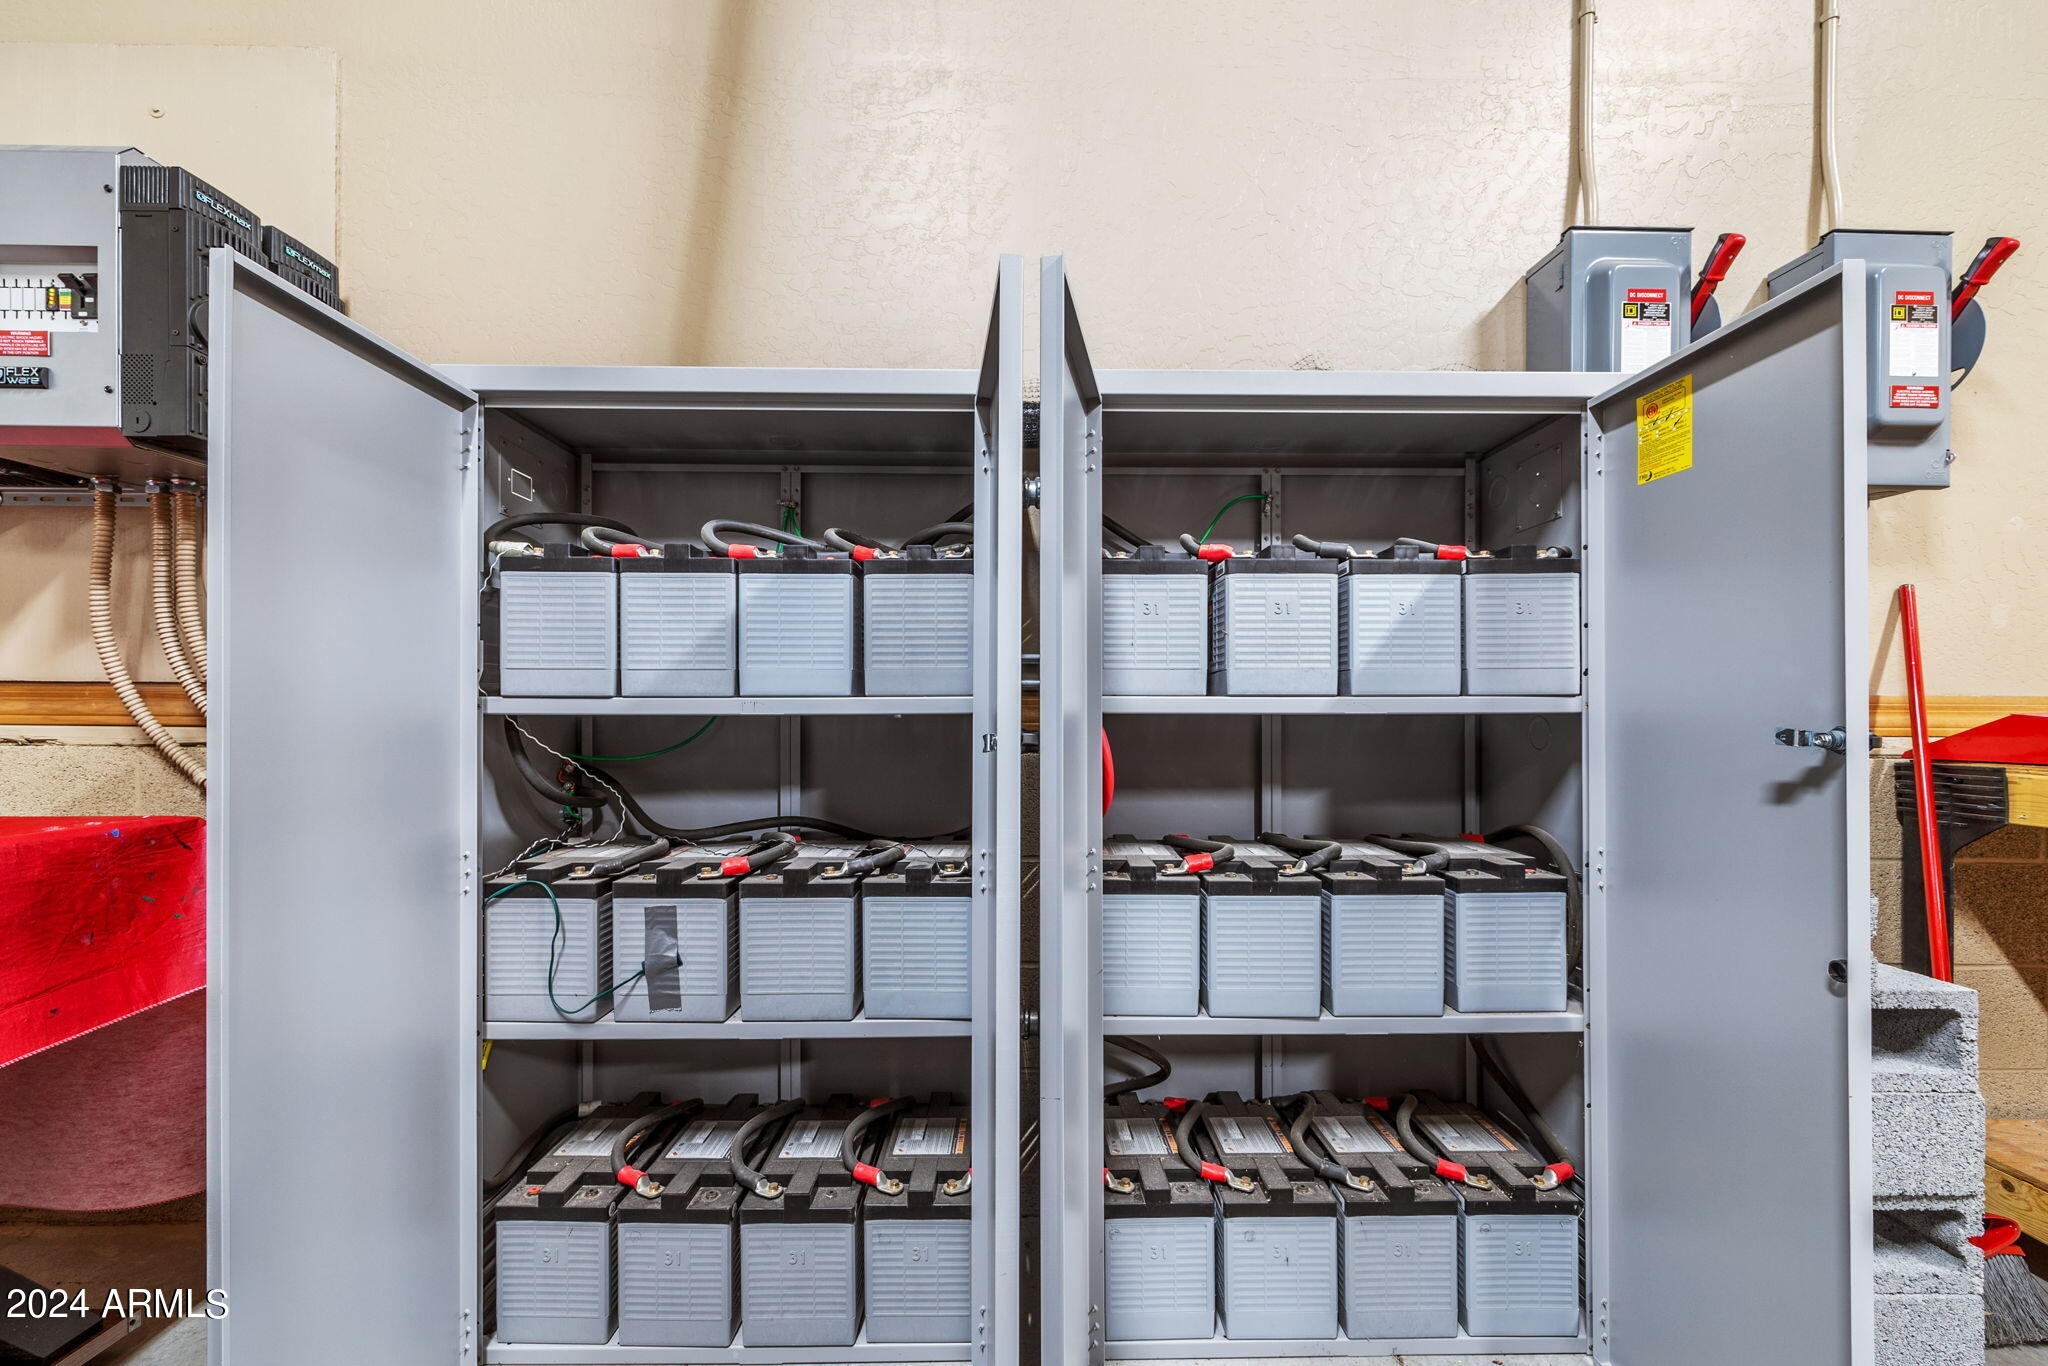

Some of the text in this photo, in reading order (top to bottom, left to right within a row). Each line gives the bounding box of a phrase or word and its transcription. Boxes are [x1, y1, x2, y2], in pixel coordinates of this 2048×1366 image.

[205, 196, 252, 231] FLEXmax
[6, 367, 39, 376] FLEX
[1142, 601, 1160, 617] 31
[1273, 601, 1291, 617] 31
[1398, 600, 1417, 617] 31
[1515, 601, 1533, 617] 31
[541, 1247, 560, 1263] 31
[911, 1246, 930, 1262] 31
[1149, 1245, 1167, 1261] 31
[1271, 1244, 1289, 1261] 31
[1392, 1242, 1411, 1258] 31
[1513, 1241, 1532, 1257] 31
[663, 1250, 681, 1266] 31
[789, 1249, 807, 1266] 31
